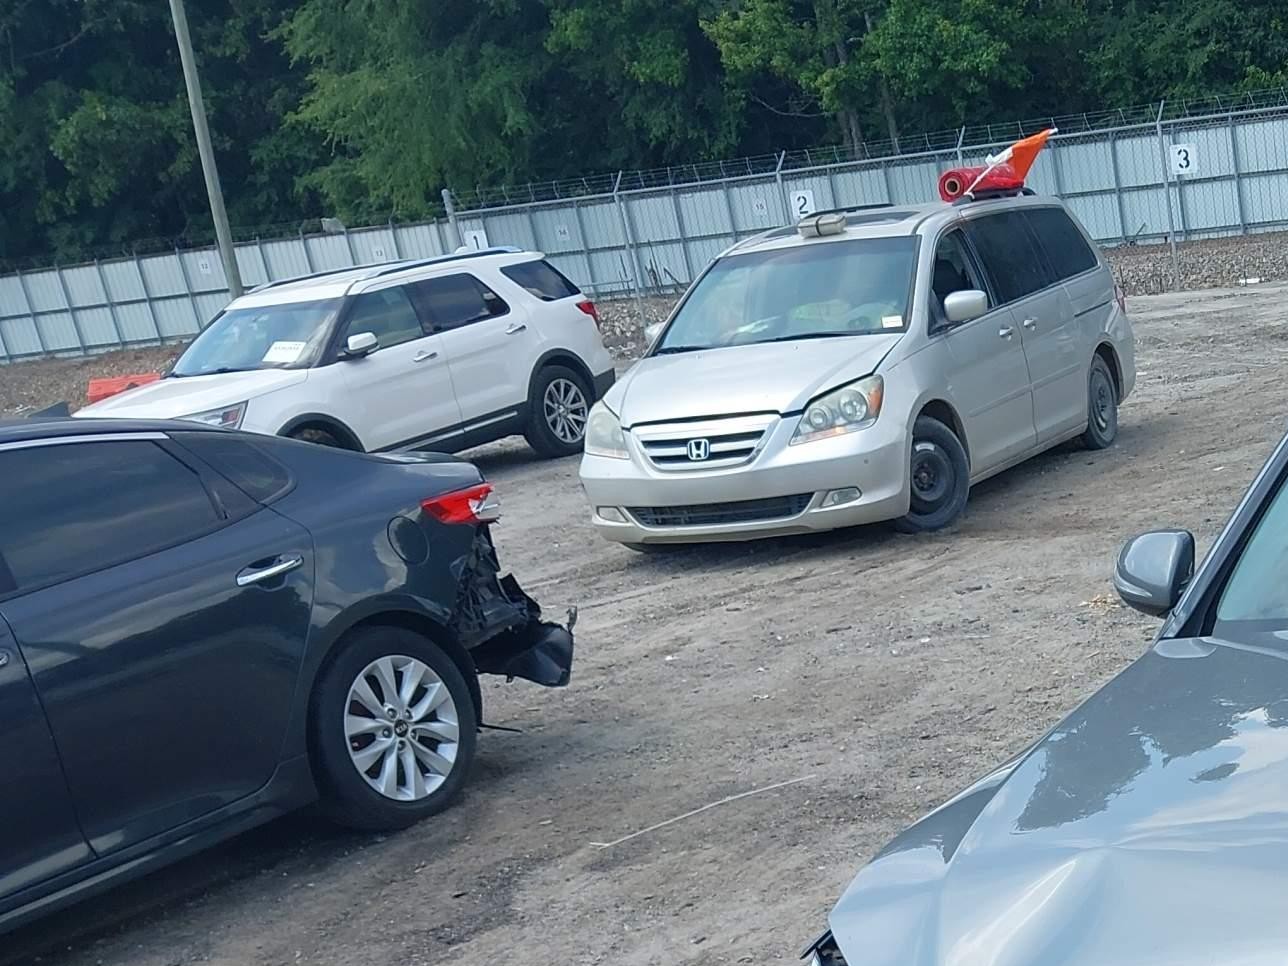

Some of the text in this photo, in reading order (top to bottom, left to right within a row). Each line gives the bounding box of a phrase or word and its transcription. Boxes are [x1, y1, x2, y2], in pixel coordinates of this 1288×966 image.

[1178, 149, 1190, 168] 3
[797, 195, 808, 214] 2
[472, 235, 480, 250] 1
